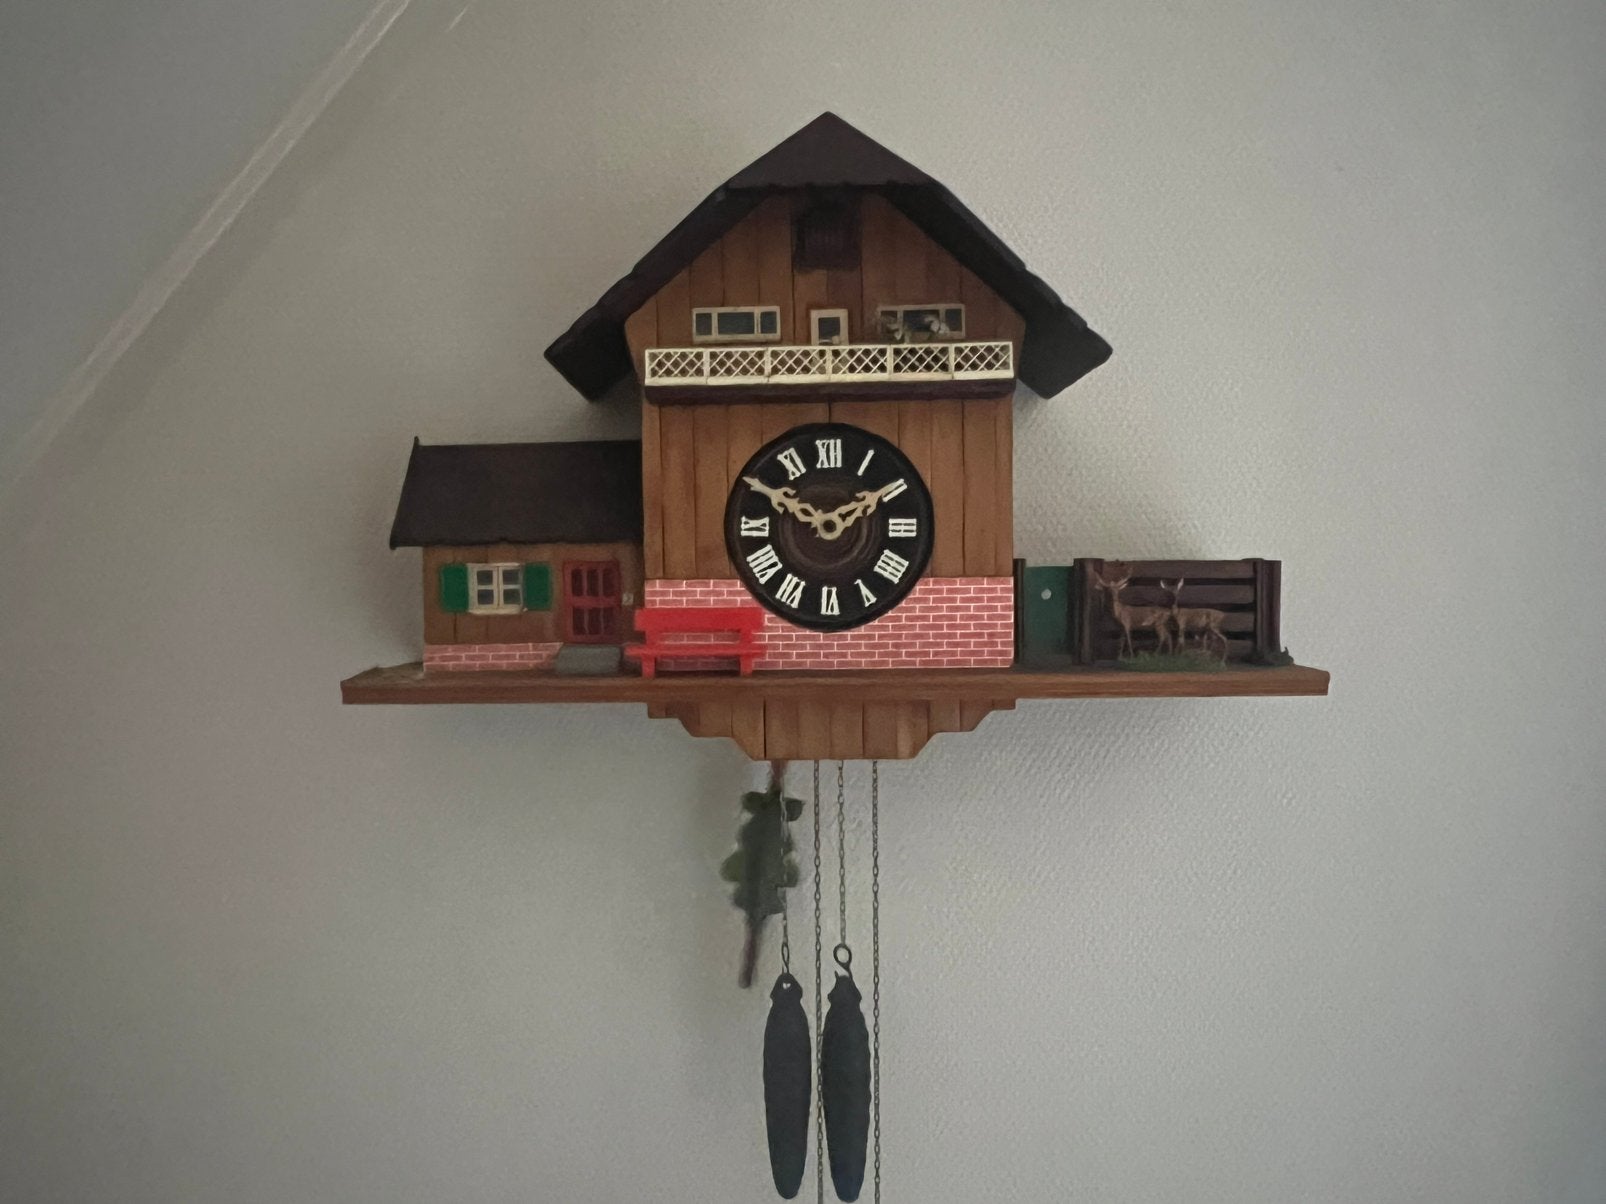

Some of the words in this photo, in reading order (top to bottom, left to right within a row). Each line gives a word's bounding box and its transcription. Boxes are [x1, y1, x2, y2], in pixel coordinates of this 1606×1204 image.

[777, 447, 806, 480] XI
[815, 438, 842, 469] XII
[857, 449, 874, 476] I
[882, 478, 908, 502] II
[740, 516, 769, 537] IX
[888, 518, 917, 537] III
[746, 544, 782, 584] VIII
[874, 549, 909, 584] IIII
[775, 573, 805, 608] VII
[820, 586, 840, 615] VI
[854, 579, 877, 607] V
